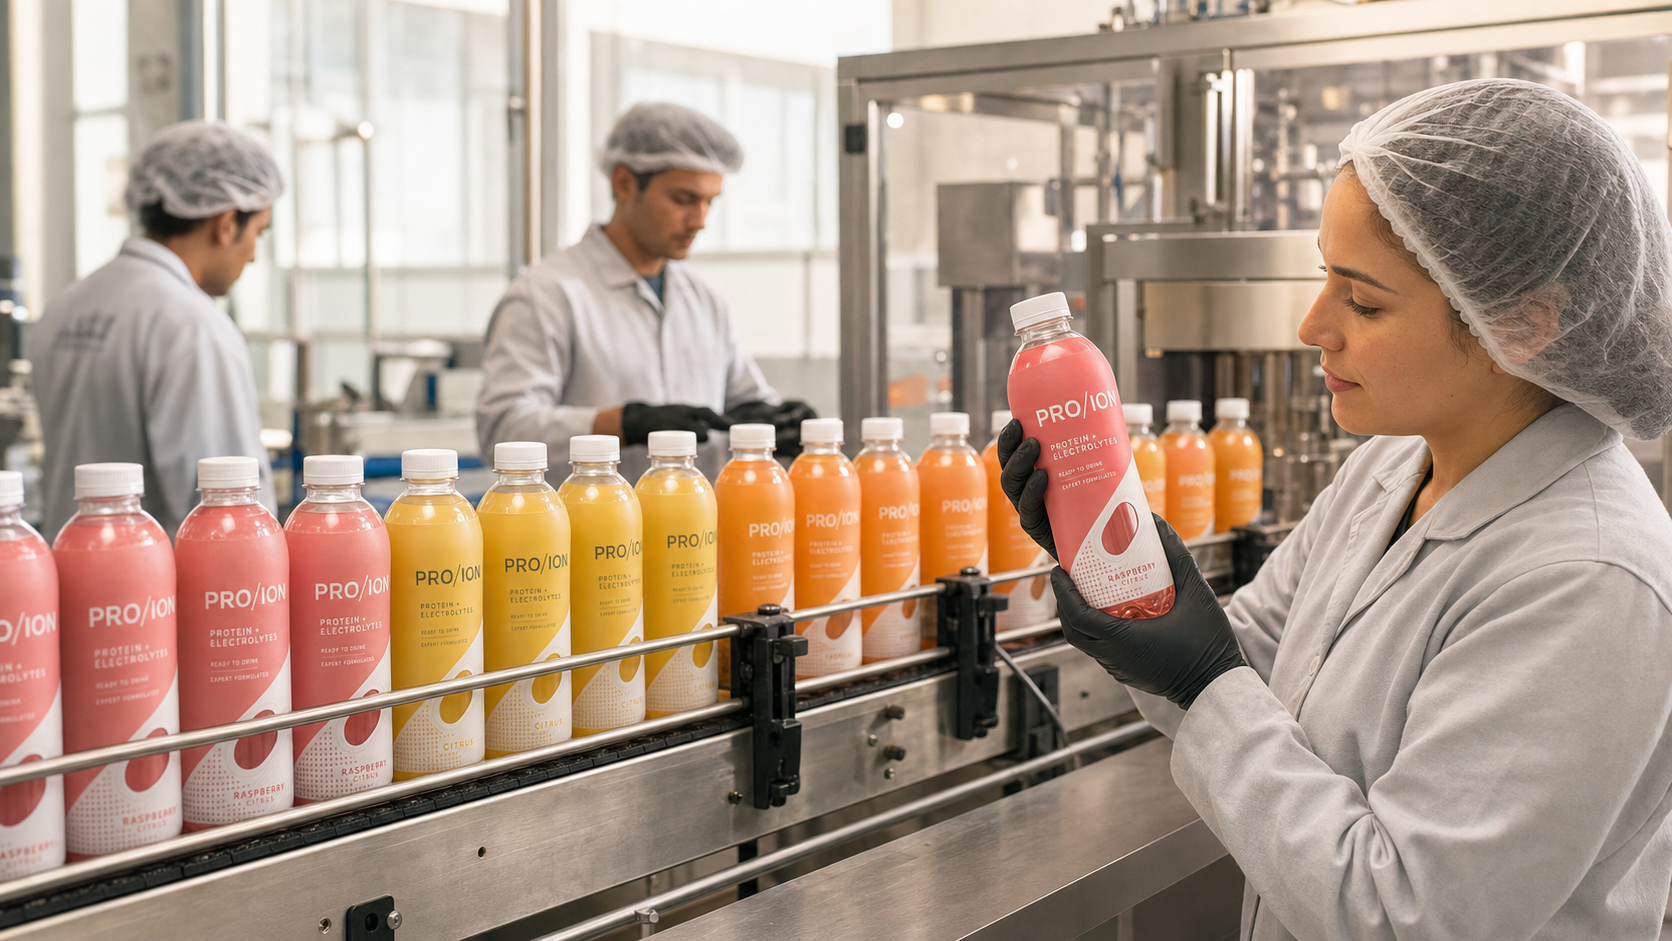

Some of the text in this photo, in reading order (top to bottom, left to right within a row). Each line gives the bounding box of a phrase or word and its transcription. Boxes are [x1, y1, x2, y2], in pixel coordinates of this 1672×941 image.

[1036, 390, 1117, 427] PRO/ION
[1051, 434, 1089, 451] PROTEIN
[1053, 437, 1118, 460] ELECTROLYTES
[1059, 468, 1075, 477] READY
[806, 509, 859, 530] PRO/ION
[505, 553, 568, 574] PRO/ION
[1108, 562, 1156, 582] RASPBERRY
[416, 564, 480, 587] PRO/ION
[599, 574, 627, 582] PROTEIN
[205, 582, 286, 611] PRO/ION
[315, 575, 389, 602] PRO/ION
[420, 602, 454, 610] PROTEIN
[510, 593, 561, 604] ELECTROLYTES
[89, 595, 175, 628] PRO/ION
[420, 607, 473, 618] ELECTROLYTES
[0, 612, 56, 646] O/ION
[320, 616, 360, 626] PROTEIN
[320, 621, 383, 636] ELECTROLYTES
[210, 627, 252, 637] PROTEIN
[210, 633, 278, 648] ELECTROLYTES
[94, 643, 141, 658] PROTEIN
[94, 648, 168, 669] ELECTROLYTES
[535, 718, 563, 730] CITRUS
[443, 738, 474, 751] CITRUS
[341, 759, 387, 776] RASPBERRY
[233, 783, 285, 800] RASPBERRY
[122, 806, 177, 825] RASPBERRY
